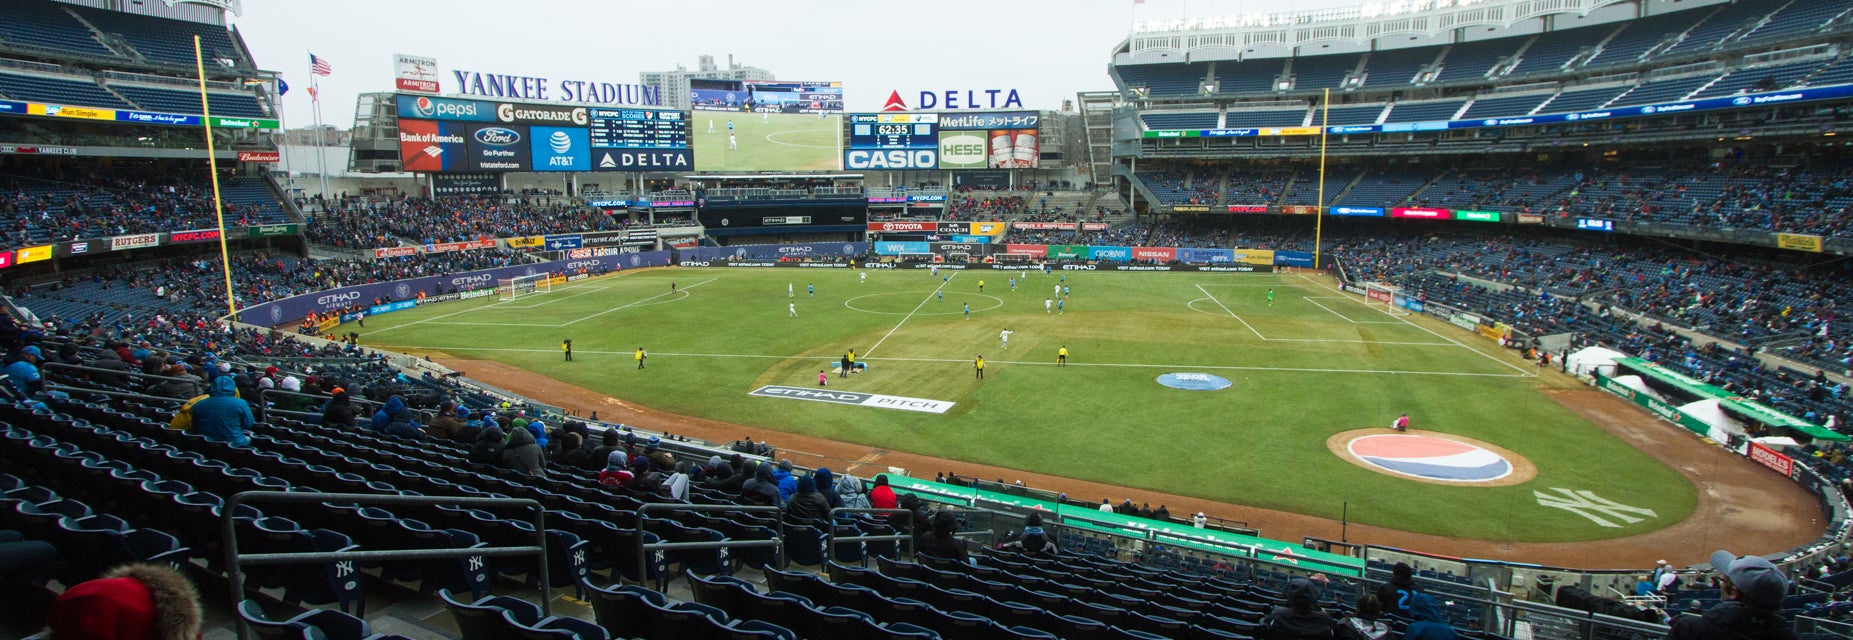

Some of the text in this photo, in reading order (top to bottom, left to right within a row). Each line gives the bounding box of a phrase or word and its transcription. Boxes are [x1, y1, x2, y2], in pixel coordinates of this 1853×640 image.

[399, 57, 436, 67] ARMITRON
[403, 80, 436, 89] ARMITRON
[452, 69, 660, 106] YANKEE STADIUM
[920, 88, 1023, 110] DELTA
[62, 108, 75, 116] Run
[76, 110, 98, 118] Simple
[436, 103, 477, 117] pepsi
[498, 103, 587, 125] G GATORADE G
[940, 115, 985, 128] MetLife
[988, 116, 1038, 126] メットライフ
[879, 125, 908, 134] 62:35
[400, 133, 464, 143] Bank of America
[482, 129, 513, 143] Ford
[63, 147, 77, 155] CLUB
[943, 144, 983, 156] HESS
[239, 152, 279, 162] Budweiser
[549, 156, 574, 166] AT&T
[622, 153, 687, 166] DELTA
[849, 150, 936, 169] CASIO
[115, 235, 156, 247] RUTGERS
[172, 231, 219, 242] NYCFC.COM
[567, 259, 600, 269] ETIHAD
[452, 273, 492, 285] ETIHAD
[317, 291, 361, 305] ETIHAD
[438, 293, 460, 301] ETIHAD
[460, 288, 494, 300] Heineken
[326, 300, 352, 308] AIRWAYS
[1606, 380, 1630, 398] Heineken
[765, 387, 939, 409] ETIHAD PITCH
[1647, 398, 1675, 420] Heineken
[573, 549, 585, 566] NY
[654, 549, 664, 563] NY
[720, 546, 728, 559] NY
[335, 560, 354, 578] NY
[468, 555, 484, 572] NY
